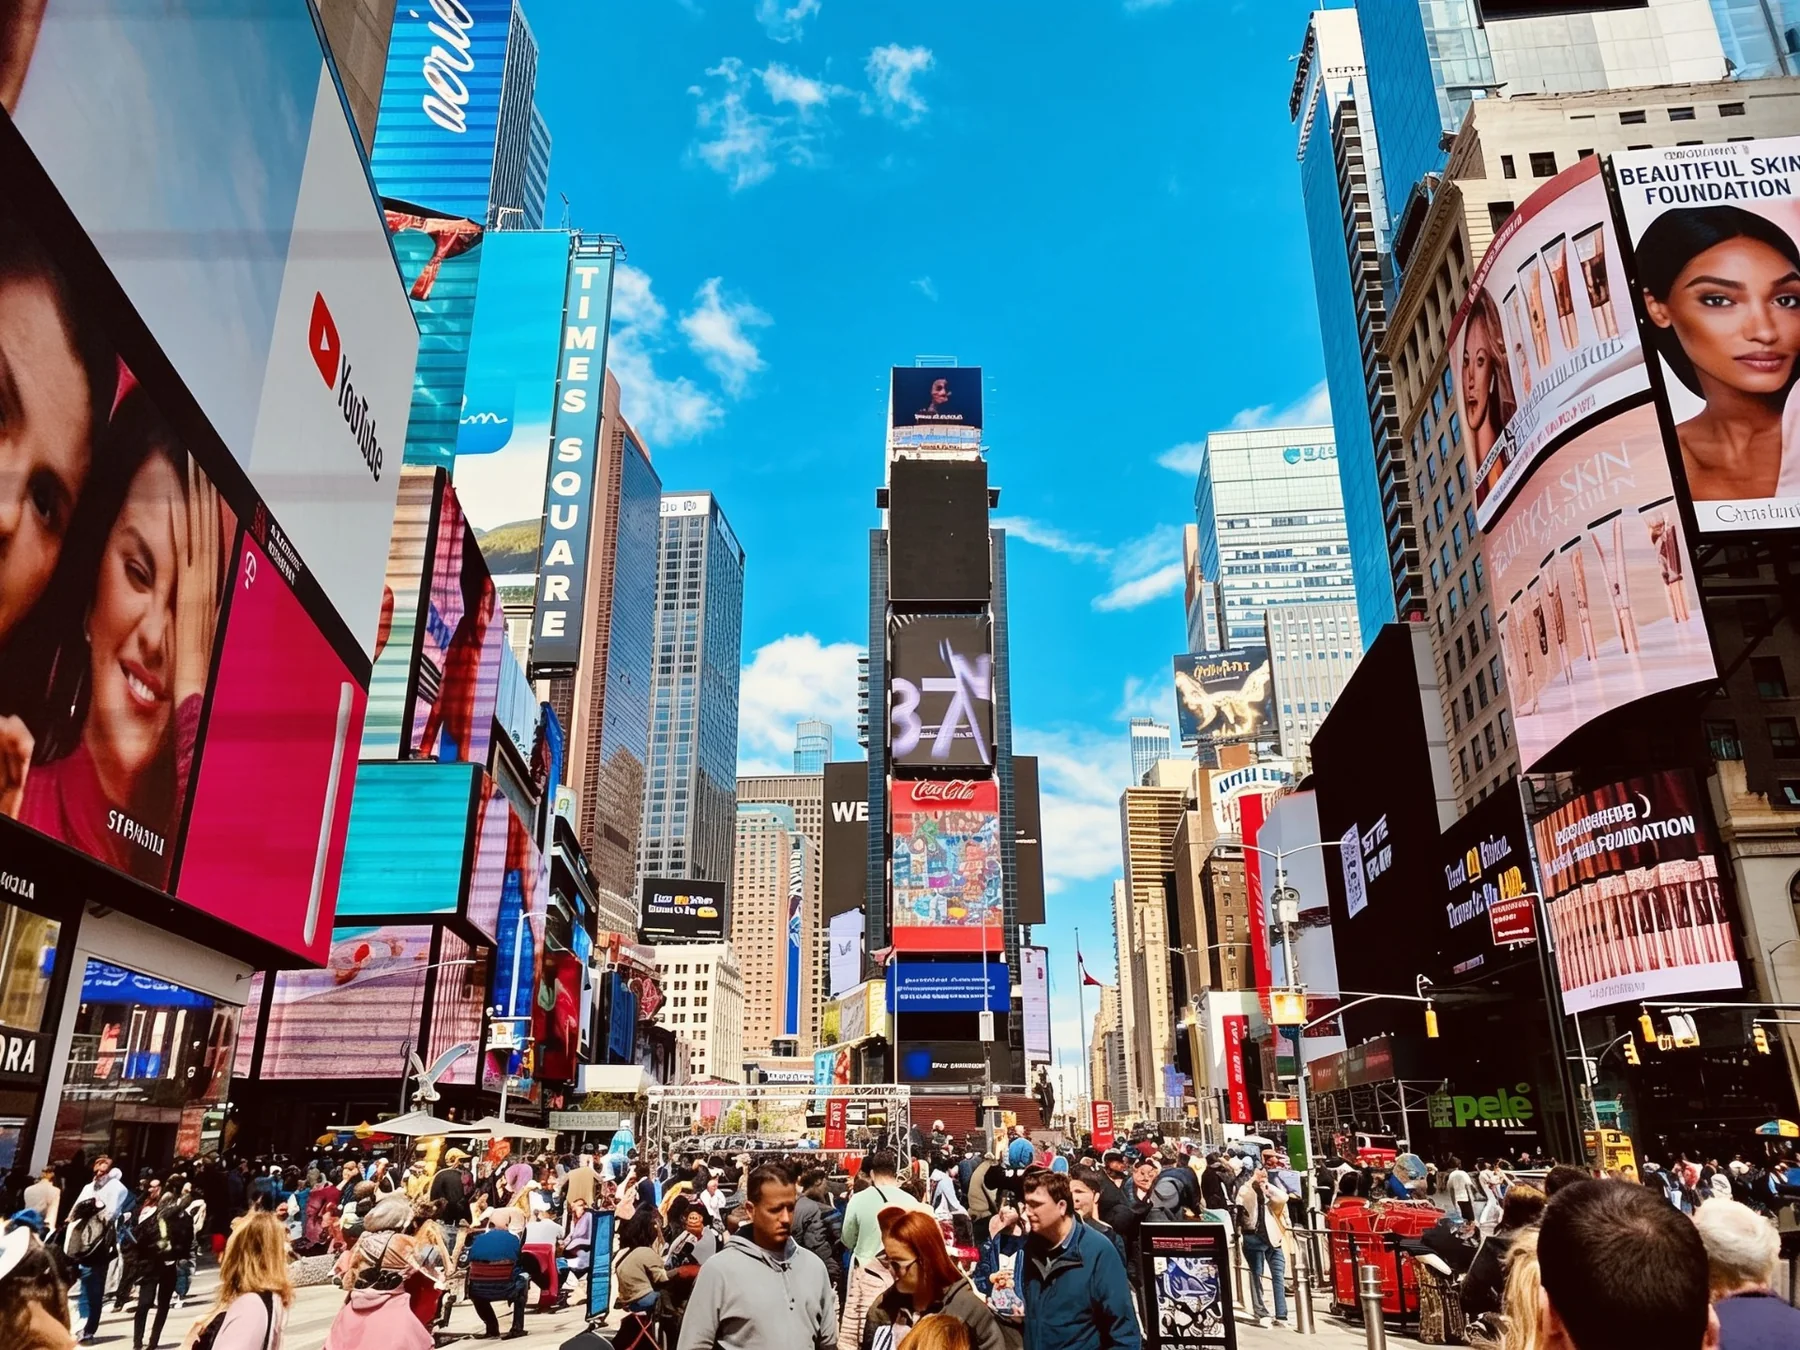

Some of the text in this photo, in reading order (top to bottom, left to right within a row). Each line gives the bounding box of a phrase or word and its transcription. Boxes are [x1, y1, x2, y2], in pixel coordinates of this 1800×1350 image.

[1619, 155, 1800, 186] BEAUTIFUL SKIN
[1645, 178, 1792, 205] FOUNDATION
[338, 353, 383, 483] YouTube
[540, 266, 600, 637] TIMES SQUARE
